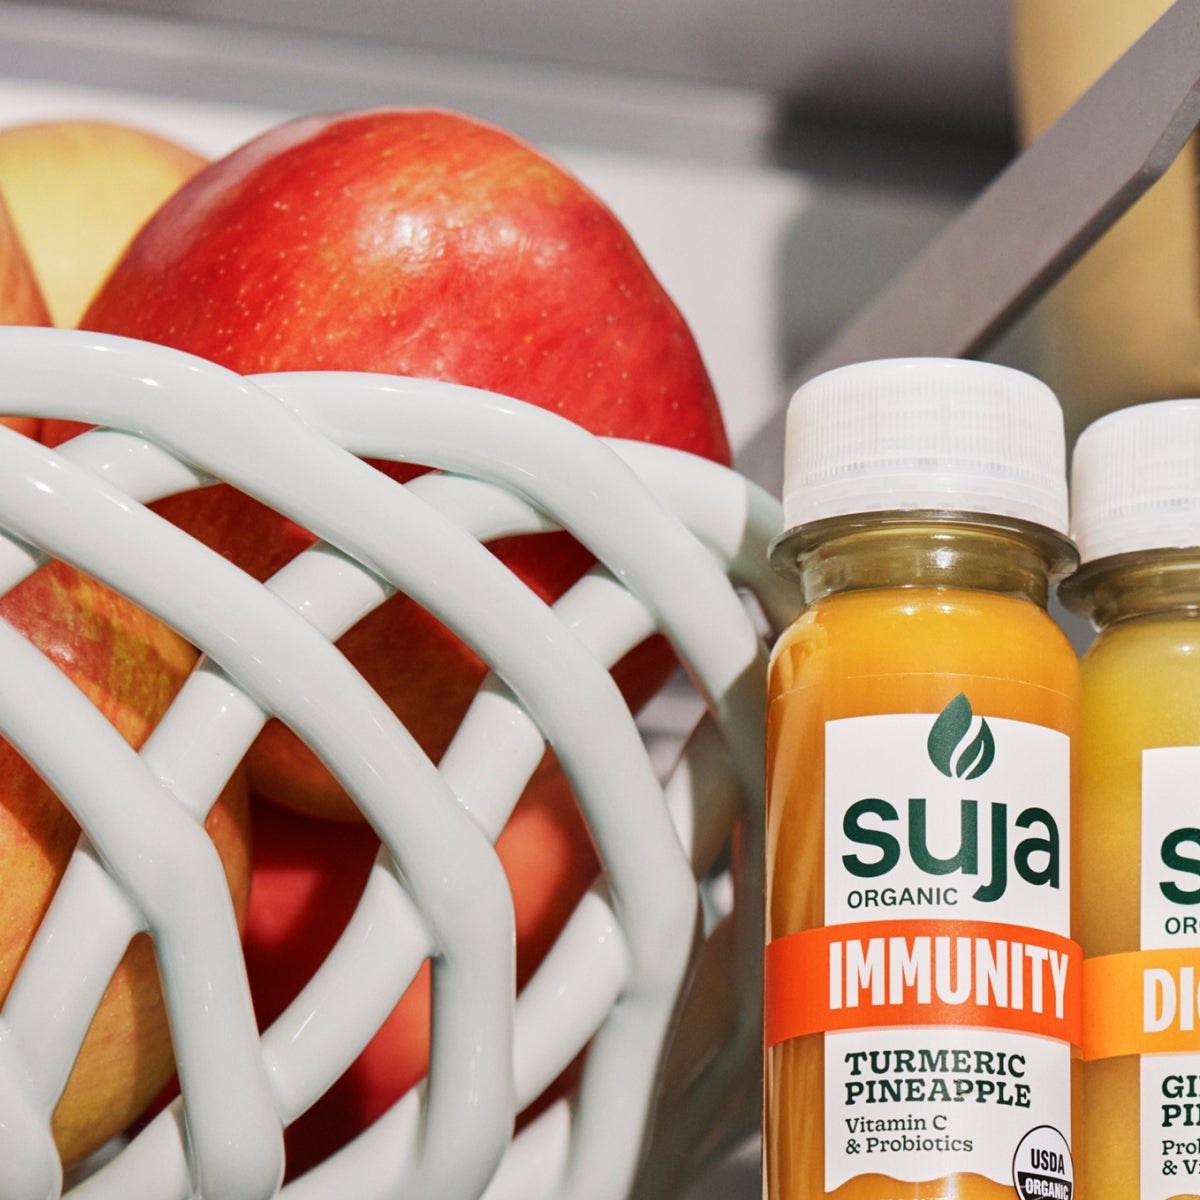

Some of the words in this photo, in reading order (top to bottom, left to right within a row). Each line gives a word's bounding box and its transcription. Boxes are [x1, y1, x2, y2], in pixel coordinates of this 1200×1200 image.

[841, 798, 1060, 903] suja
[847, 887, 959, 909] ORGANIC
[828, 936, 1069, 1020] IMMUNITY
[844, 1049, 1026, 1078] TURMERIC
[844, 1078, 1031, 1108] PINEAPPLE
[845, 1115, 927, 1133] Vitamin
[933, 1115, 947, 1130] C
[845, 1138, 861, 1154] &
[866, 1135, 973, 1153] Probiotics
[1030, 1148, 1065, 1175] USDA
[1162, 1159, 1178, 1175] &
